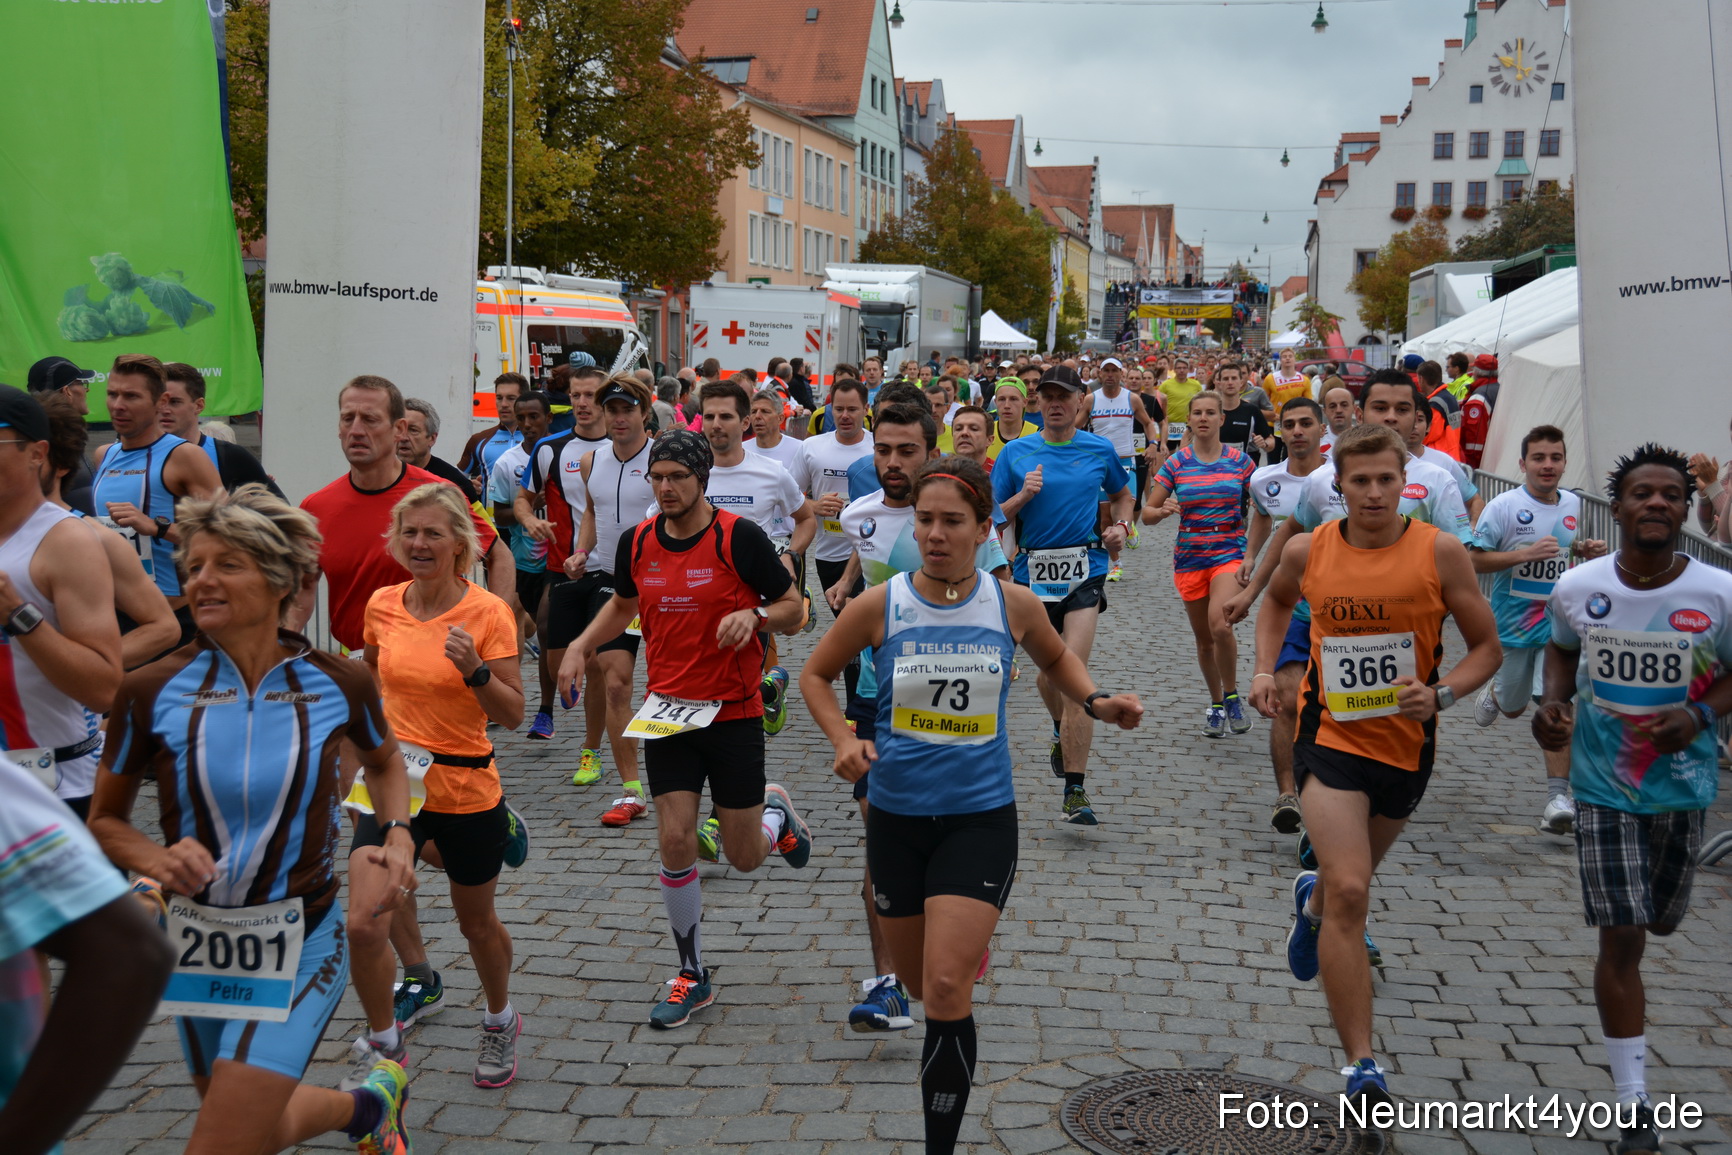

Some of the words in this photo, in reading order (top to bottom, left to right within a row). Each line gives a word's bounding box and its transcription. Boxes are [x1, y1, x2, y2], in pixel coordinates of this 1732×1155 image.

[269, 279, 438, 302] www.bmw-laufsport.de
[1168, 308, 1200, 316] START
[749, 321, 793, 330] Bayerisches
[749, 330, 770, 338] Rotes
[748, 339, 770, 347] Kreuz
[1035, 560, 1085, 581] 2024
[1519, 560, 1566, 580] 3089
[1331, 604, 1390, 621] OEXL
[919, 643, 953, 654] TELIS
[958, 643, 1001, 656] FINANZ
[1323, 645, 1350, 653] PARTL
[1352, 642, 1397, 653] Neumarkt
[1588, 635, 1621, 646] PARTL
[1623, 639, 1673, 649] Neumarkt
[897, 664, 932, 674] PARTL
[935, 664, 984, 673] Neumarkt
[1339, 654, 1397, 688] 366
[1597, 649, 1682, 683] 3088
[928, 678, 970, 712] 73
[1346, 692, 1394, 709] Richard
[651, 701, 703, 723] 247
[910, 713, 979, 733] Eva-Maria
[179, 926, 286, 971] 2001
[209, 980, 254, 1001] Petra
